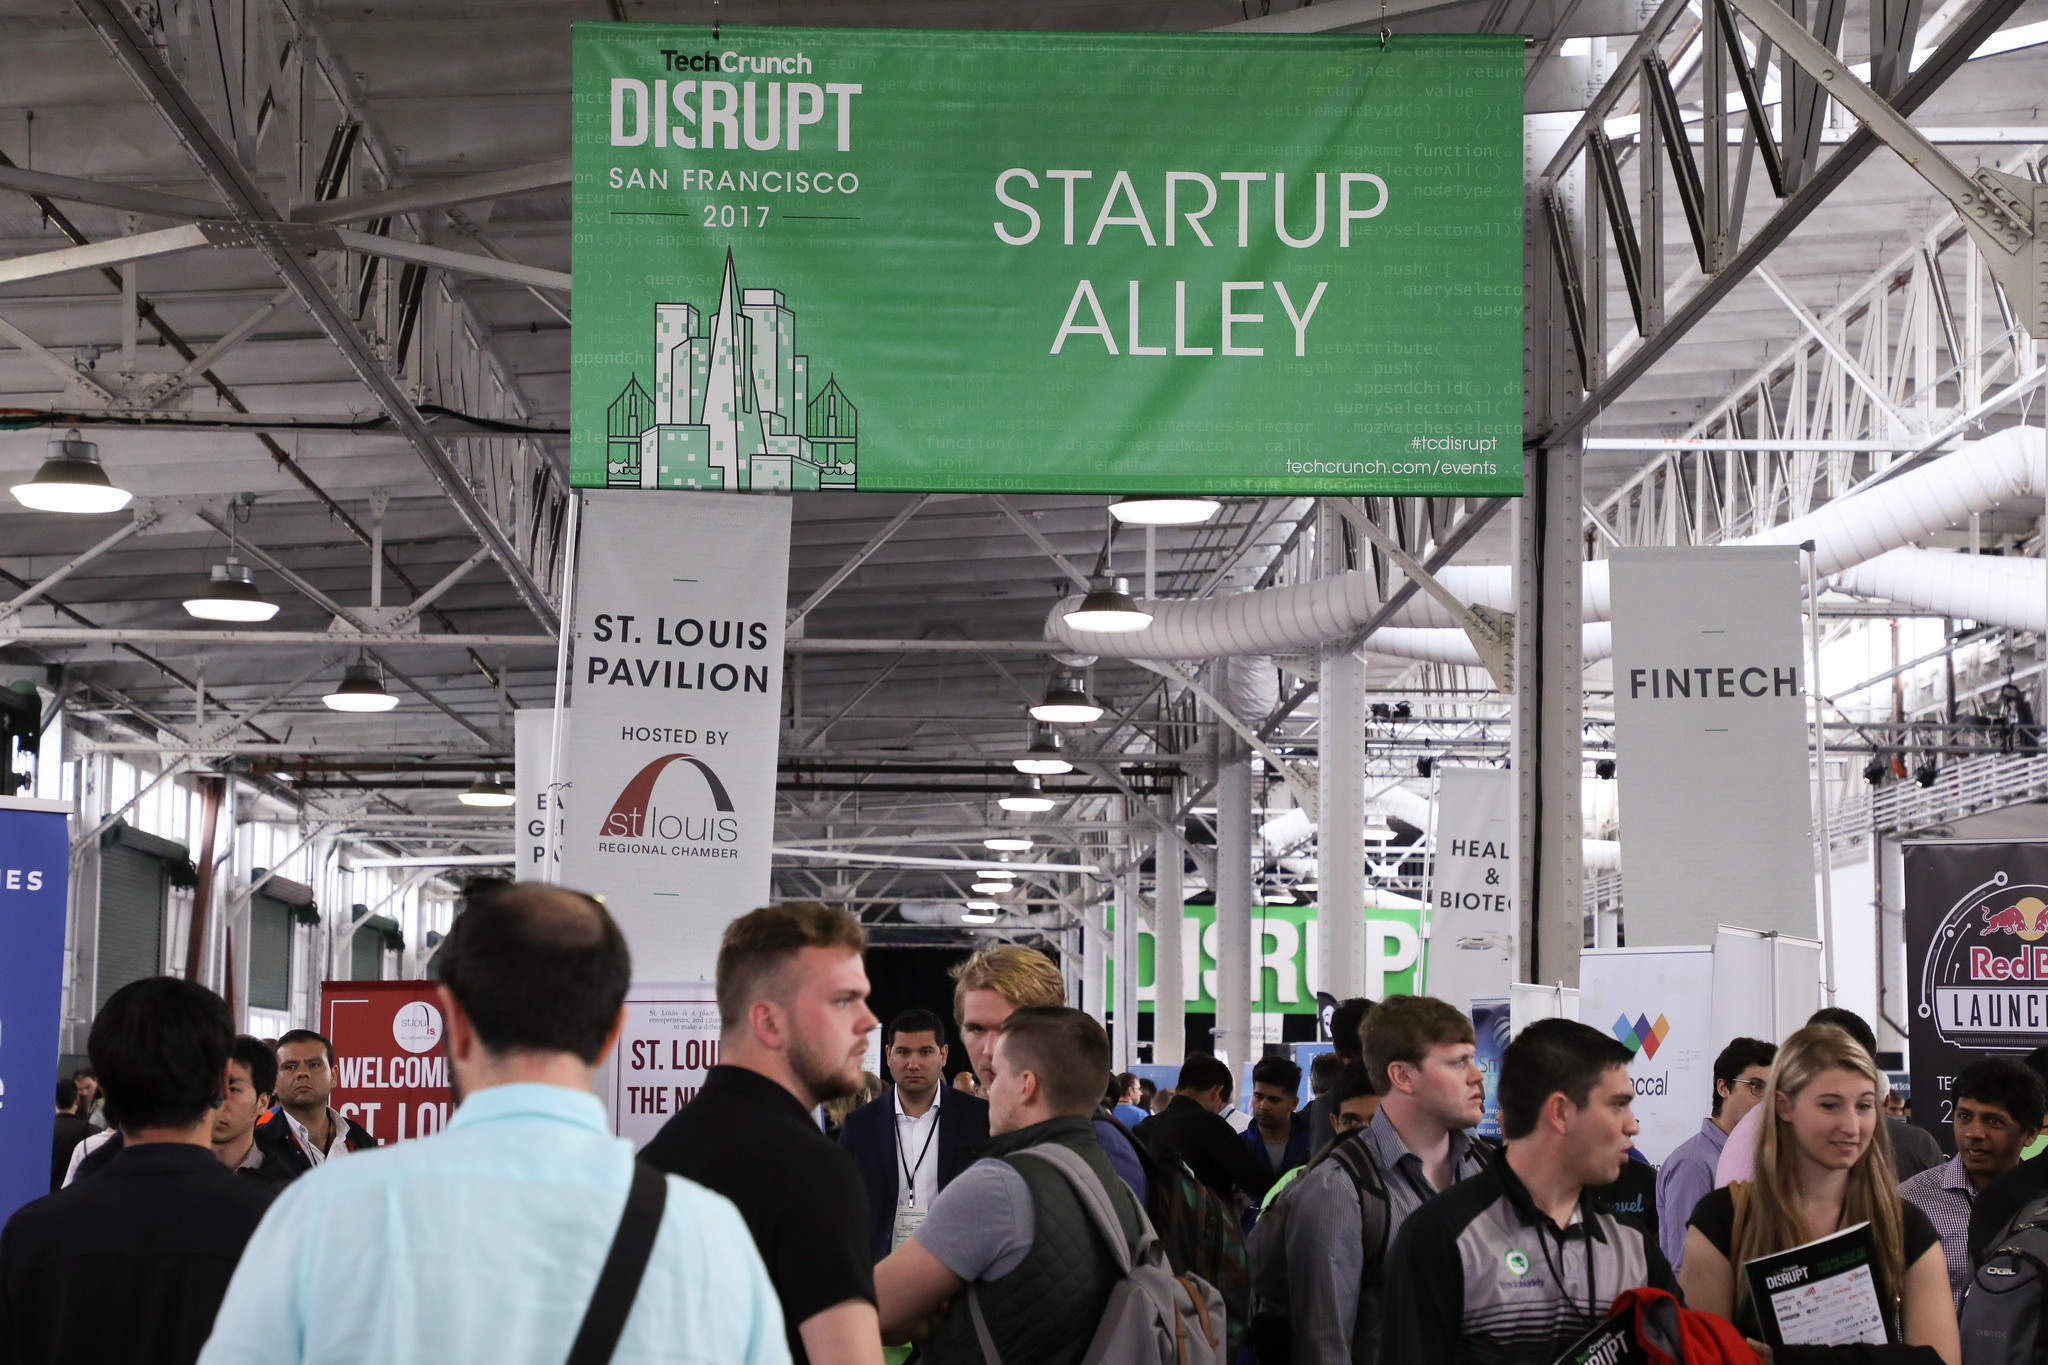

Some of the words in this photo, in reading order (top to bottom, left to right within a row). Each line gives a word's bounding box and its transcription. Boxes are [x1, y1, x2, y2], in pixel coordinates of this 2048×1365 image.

[660, 49, 813, 75] TechCrunch
[610, 77, 863, 152] DISRUPT
[608, 166, 669, 191] SAN
[682, 168, 861, 194] FRANCISCO
[702, 205, 771, 229] 2017
[993, 166, 1390, 249] STARTUP
[1048, 278, 1329, 358] ALLEY
[1410, 435, 1498, 453] #tcdisrupt
[1285, 458, 1498, 477] techcrunch.com/events
[592, 613, 642, 644] ST.
[656, 617, 769, 650] LOUIS
[587, 656, 769, 693] PAVILION
[1630, 667, 1797, 699] FINTECH
[621, 726, 698, 744] HOSTED
[705, 730, 729, 746] BY
[598, 842, 668, 856] REGIONAL
[671, 846, 738, 859] CHAMBER
[1451, 839, 1510, 860] HEAL
[0, 869, 43, 892] ES
[1484, 867, 1500, 885] &
[1440, 891, 1512, 912] BIOTE
[1969, 944, 2031, 981] Red
[1953, 993, 2048, 1027] LAUNC
[631, 1039, 664, 1071] ST.
[626, 1086, 668, 1114] THE
[1765, 1265, 1810, 1291] DISRUPT
